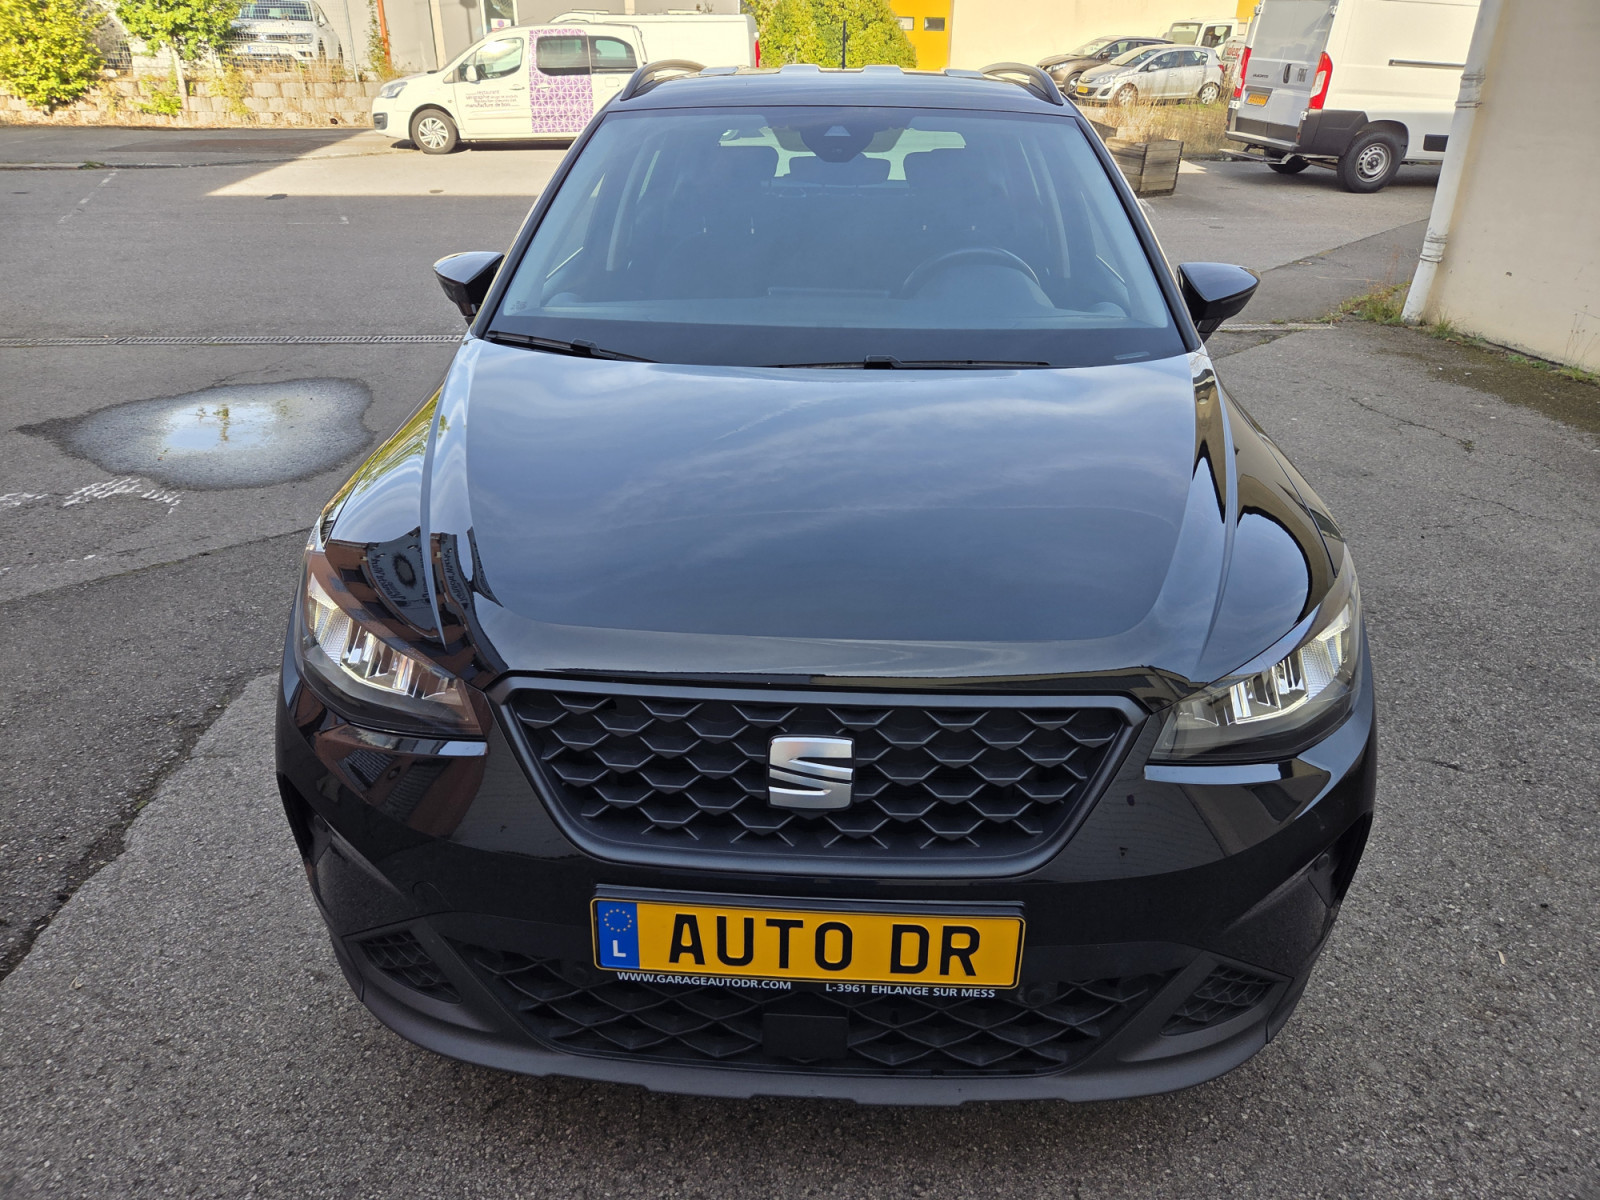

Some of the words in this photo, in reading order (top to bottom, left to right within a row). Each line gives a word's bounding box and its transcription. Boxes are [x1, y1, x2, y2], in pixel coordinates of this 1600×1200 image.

[612, 940, 627, 958] L
[668, 912, 854, 971] AUTO
[889, 923, 981, 977] DR
[616, 971, 792, 990] WWW.GARAGEAUTODR.COM
[825, 983, 867, 993] L-3961
[871, 984, 929, 996] EHLANGE
[933, 987, 957, 997] SUR
[961, 988, 996, 998] MESS
